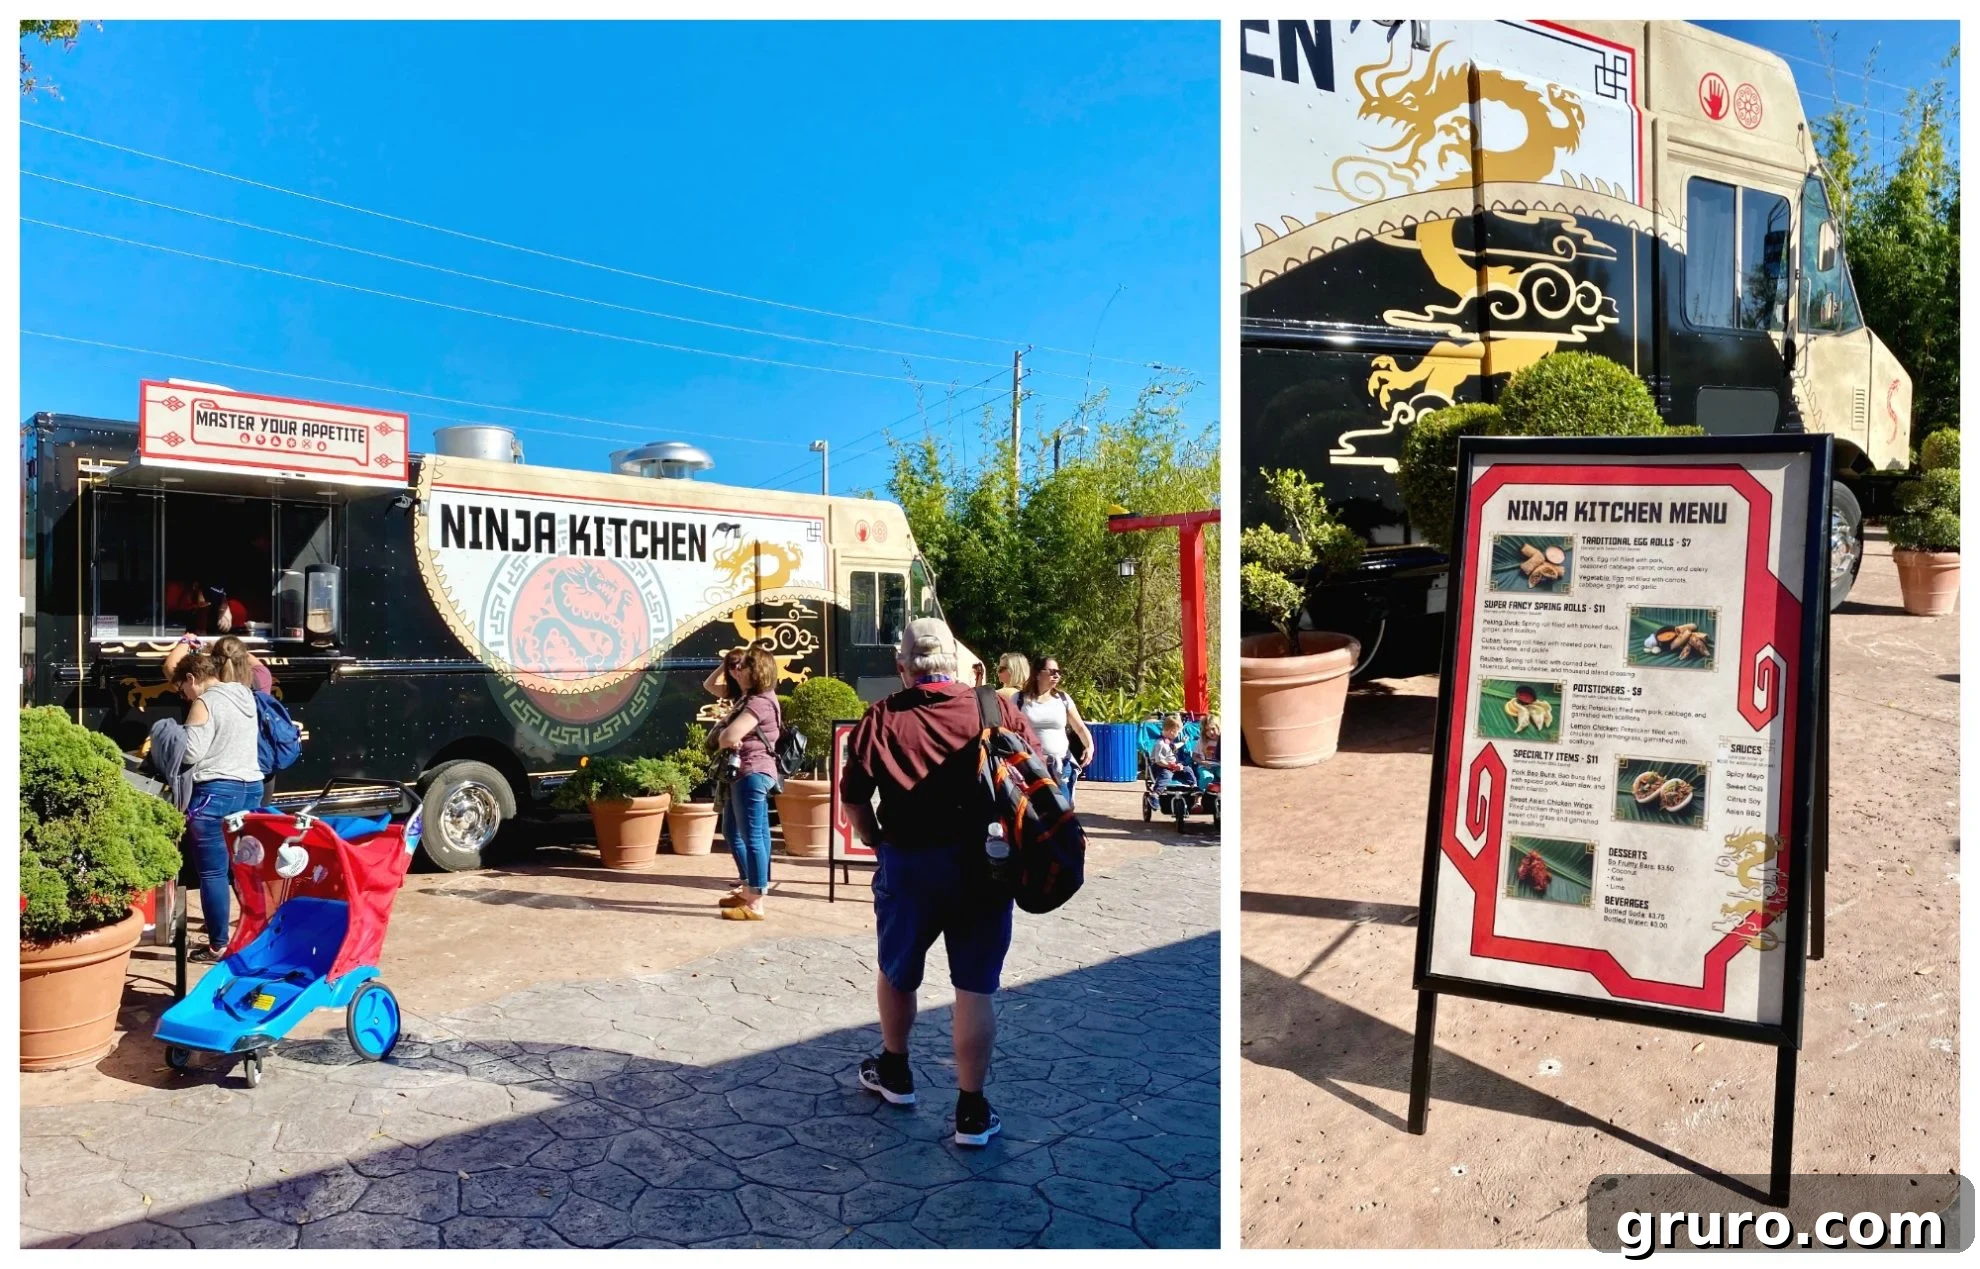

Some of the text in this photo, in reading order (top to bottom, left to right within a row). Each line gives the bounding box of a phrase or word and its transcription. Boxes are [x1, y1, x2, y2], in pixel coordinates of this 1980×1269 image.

[1240, 20, 1335, 92] EN
[196, 410, 365, 443] MASTER YOUR APPETITE
[1507, 500, 1728, 525] NINJA KITCHEN MENU
[441, 503, 707, 563] NINJA KITCHEN
[1582, 536, 1691, 547] TRADITIONAL EGG ROLLS $7
[1484, 600, 1606, 613] SUPER FANCY SPRING ROLLS $11
[1573, 683, 1625, 695] POTSTICKERS
[1694, 711, 1707, 719] and
[1570, 722, 1591, 731] Lemon
[1730, 744, 1762, 755] SAUCES
[1513, 749, 1554, 760] SPECIALTY
[1556, 752, 1580, 763] ITEMS
[1586, 754, 1599, 764] $11
[1527, 769, 1539, 777] Bao
[1571, 773, 1585, 781] buns
[1726, 770, 1765, 780] Spicy Mayo
[1726, 782, 1746, 791] Sweet
[1547, 798, 1572, 808] Chicken
[1727, 795, 1761, 806] Citrus Soy
[1726, 808, 1761, 818] Asian BBQ
[1609, 847, 1648, 860] DESSERTS
[1611, 867, 1638, 876] Coconut
[1610, 883, 1626, 891] Lime
[1605, 895, 1649, 910] BEVERAGES
[1604, 906, 1627, 916] Bottled
[1603, 915, 1627, 924] Bottled
